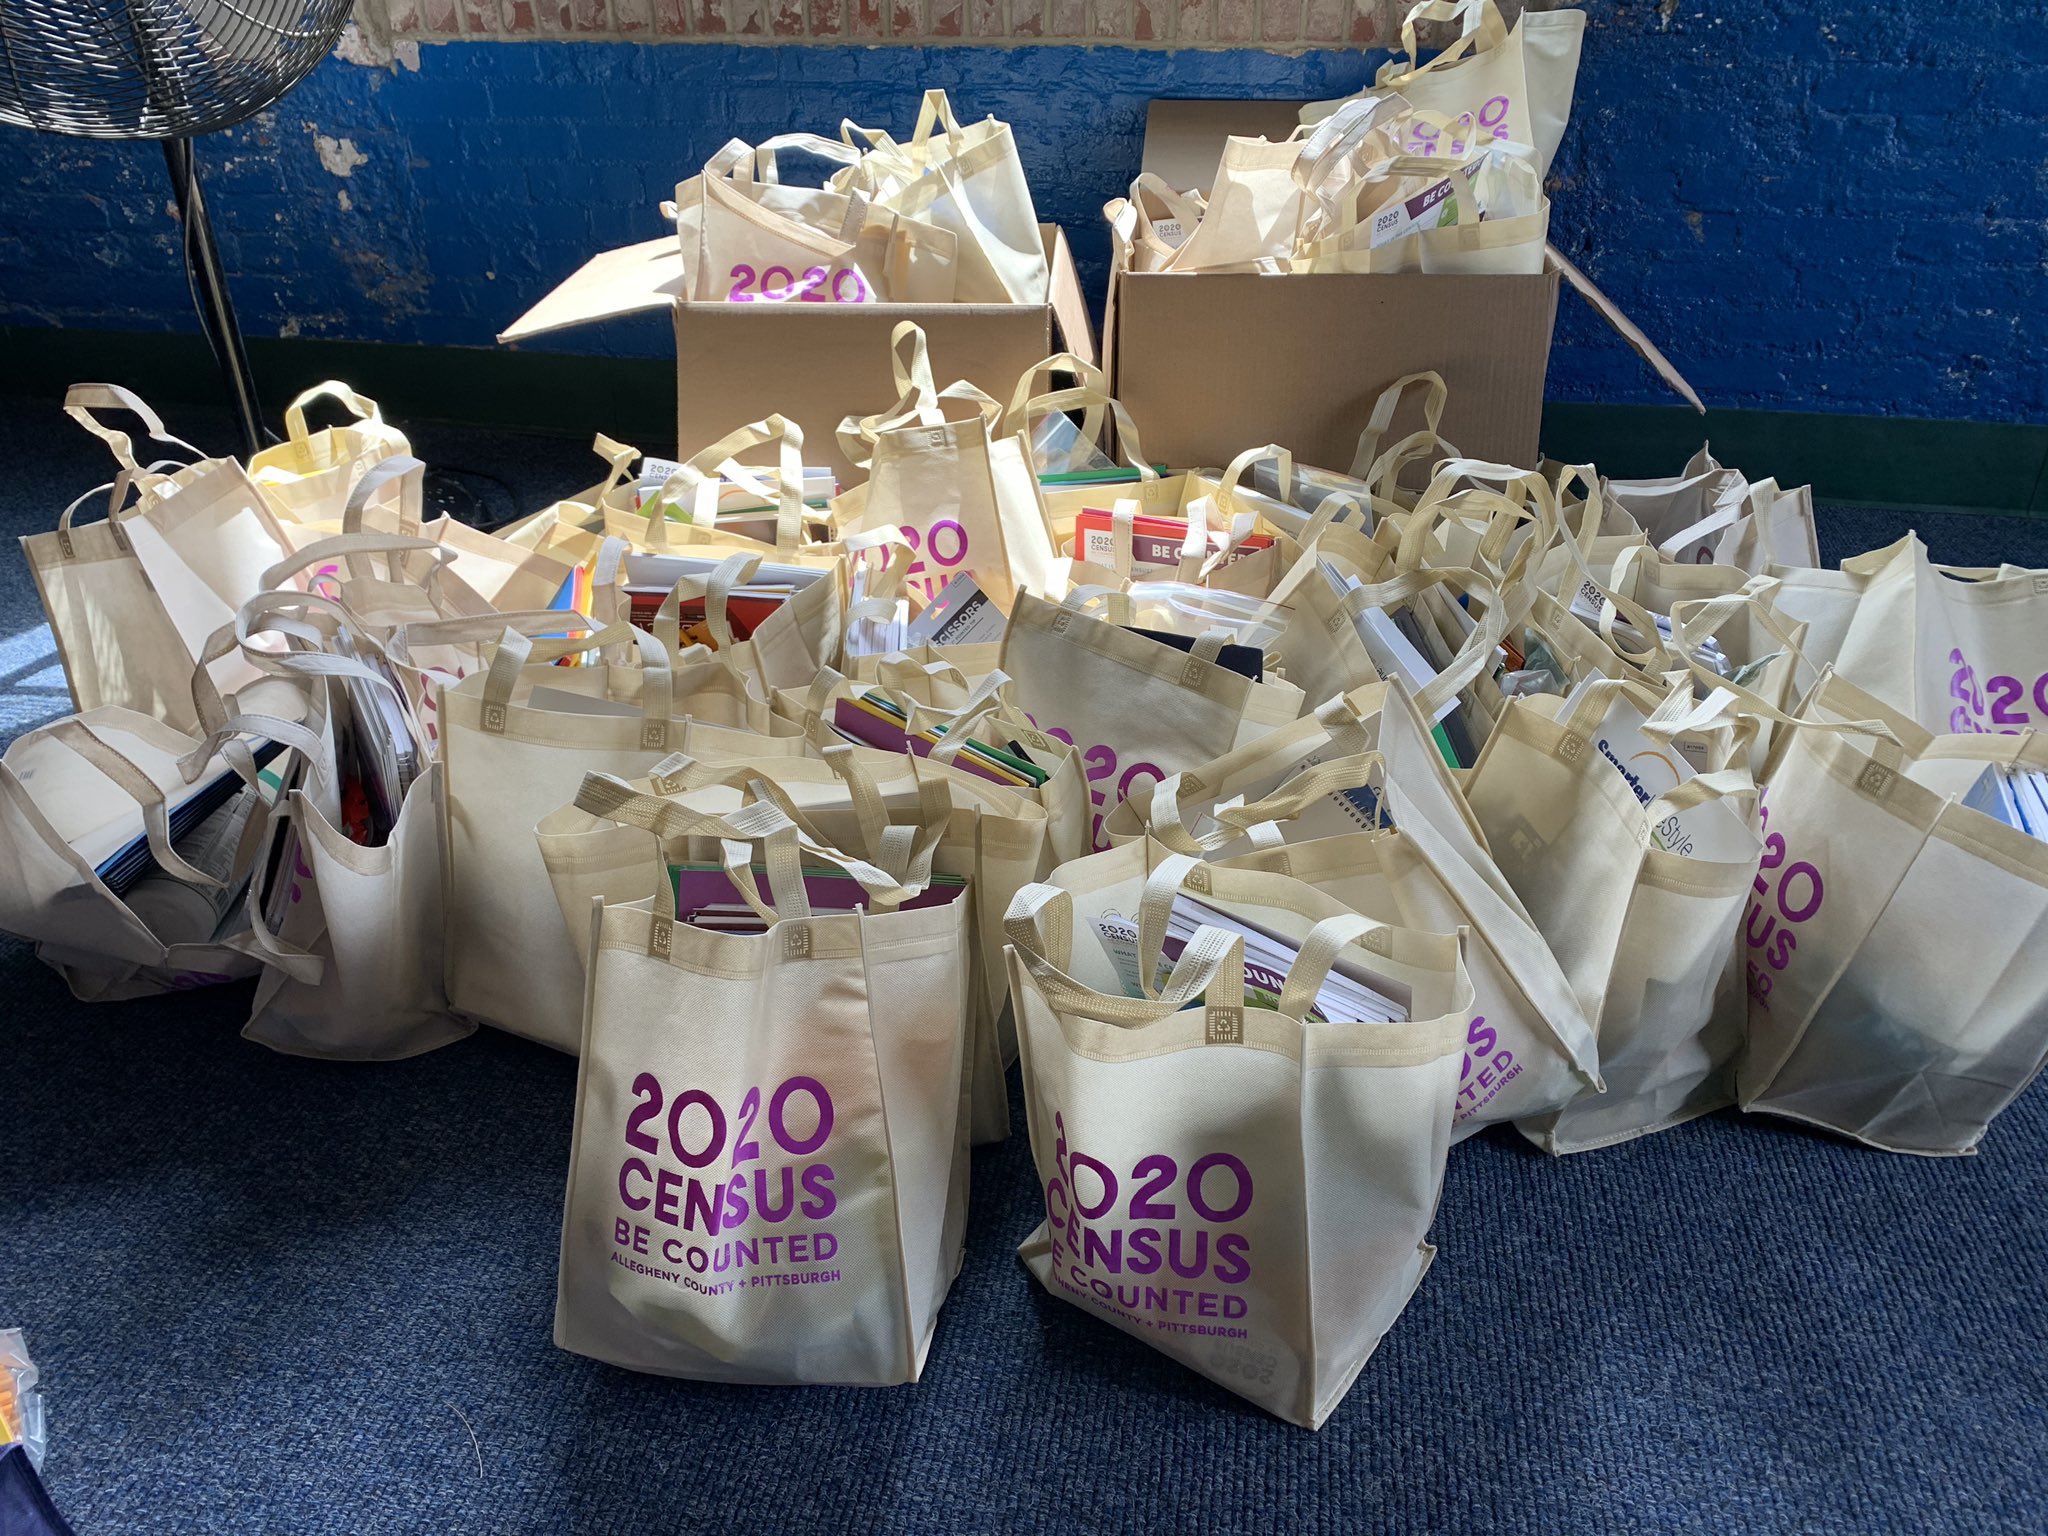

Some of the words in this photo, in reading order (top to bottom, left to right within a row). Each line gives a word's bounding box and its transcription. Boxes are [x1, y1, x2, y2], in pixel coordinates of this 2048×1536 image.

[1377, 210, 1399, 227] 2020
[1423, 193, 1437, 208] BE
[1159, 223, 1182, 233] 2020
[1376, 219, 1399, 232] CENSUS
[729, 263, 866, 303] 2020
[1152, 544, 1170, 559] BE
[1583, 580, 1606, 606] 2020
[935, 600, 981, 646] SCISSORS
[1099, 923, 1137, 939] 2020
[1113, 949, 1137, 959] WHAT
[1460, 1063, 1524, 1120] PITTSBURGH
[625, 1071, 835, 1170] 2020
[1055, 1110, 1254, 1224] 2020
[618, 1157, 837, 1237] CENSUS
[614, 1216, 651, 1256] BE
[662, 1232, 839, 1274] COUNTED
[1046, 1177, 1252, 1285] CENSUS
[611, 1251, 681, 1284] ALLEGHENY
[684, 1276, 736, 1297] COUNTY
[751, 1269, 841, 1288] PITTSBURGH
[1070, 1265, 1249, 1320] COUNTED
[1091, 1296, 1143, 1325] COUNTY
[1158, 1320, 1248, 1340] PITTSBURGH
